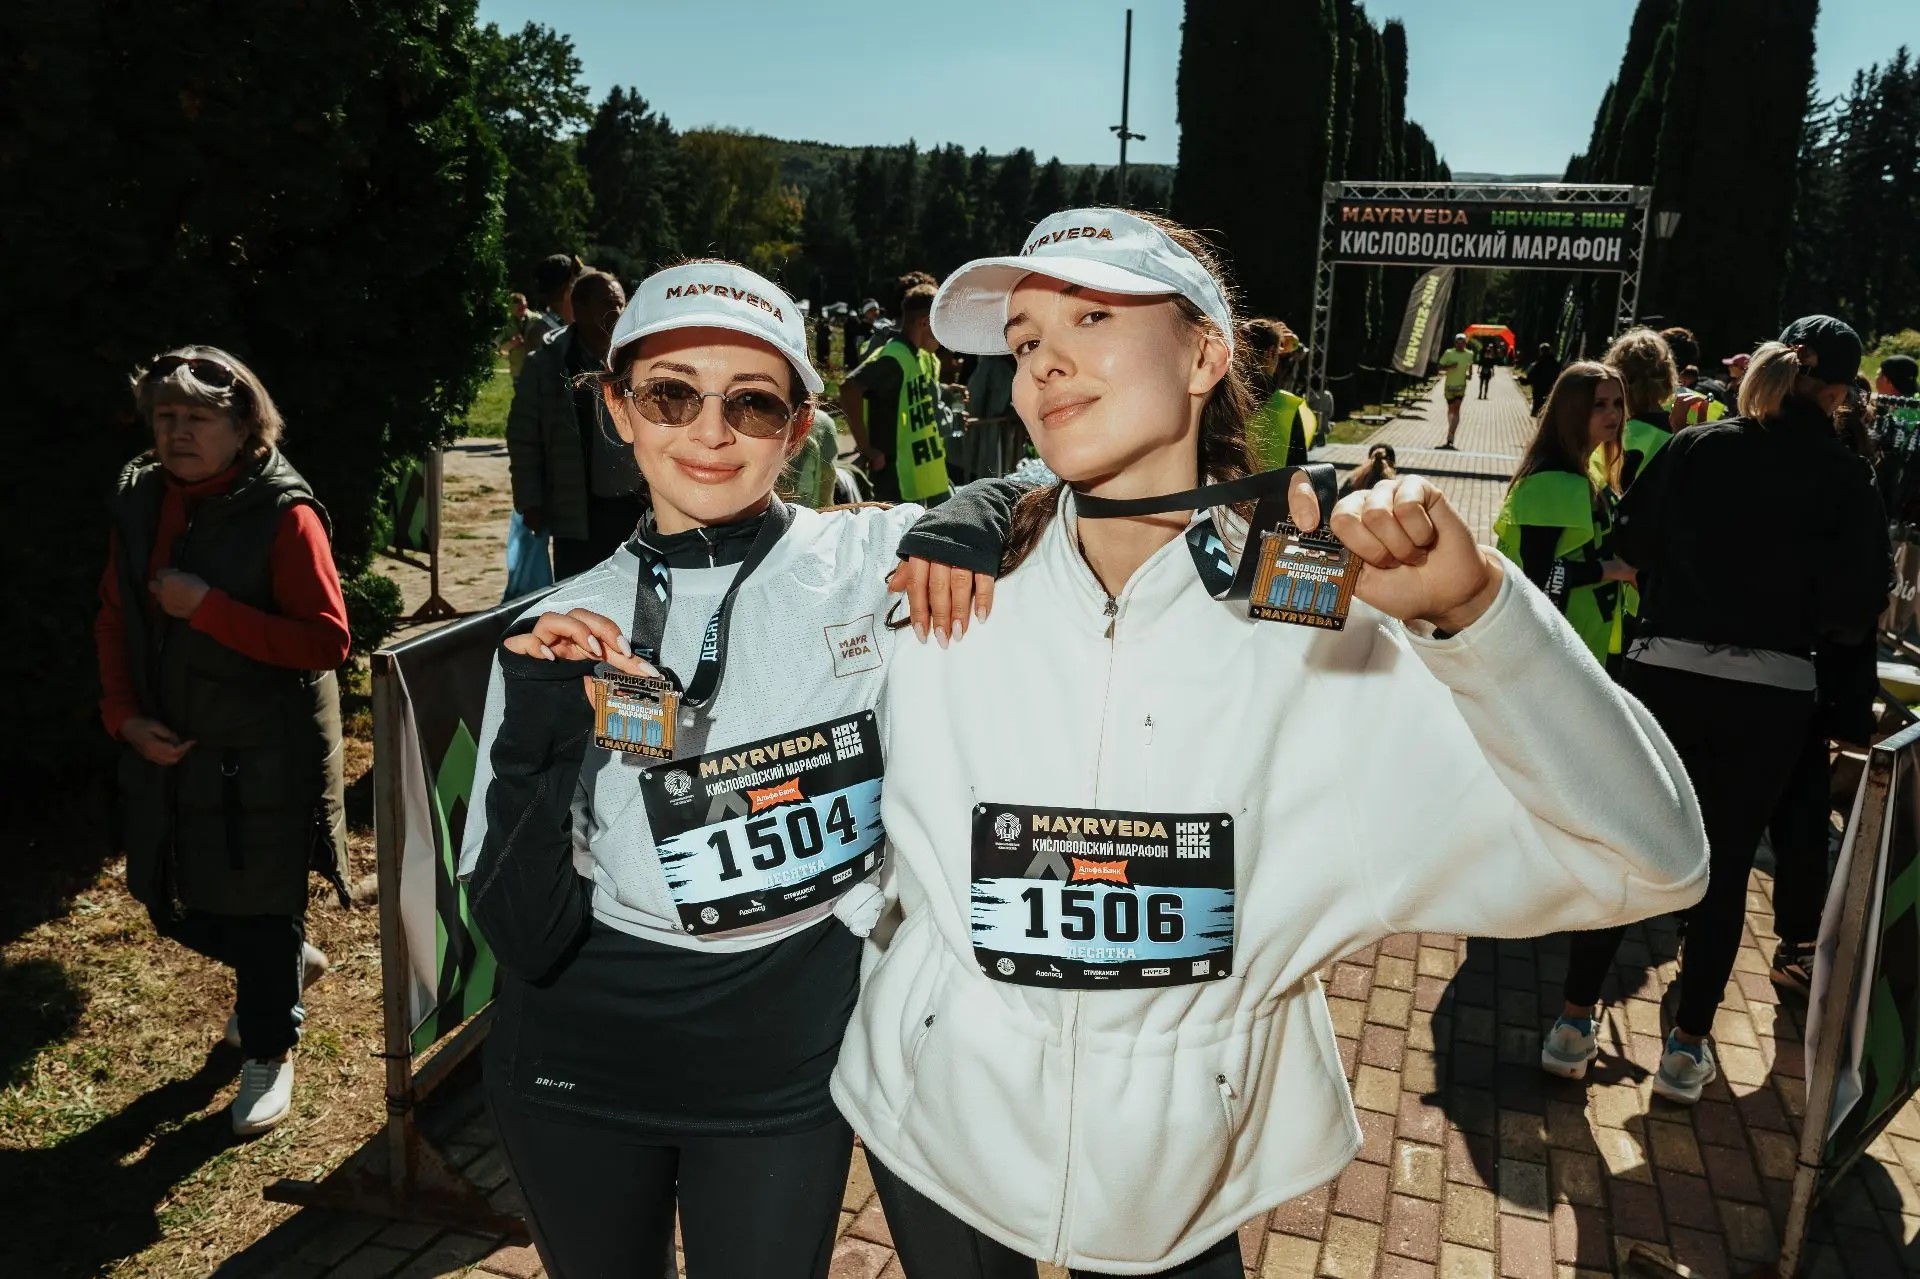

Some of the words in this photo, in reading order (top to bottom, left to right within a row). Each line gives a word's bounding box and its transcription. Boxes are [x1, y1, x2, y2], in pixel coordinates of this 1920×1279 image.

[1342, 206, 1469, 225] MAYRVEDA
[1340, 230, 1506, 259] КИСЛОВОДСКИЙ
[1511, 235, 1622, 263] МАРАФОН
[665, 283, 784, 323] MAYRVEDA
[1275, 560, 1345, 578] КИСЛОВОДСКИЙ
[1287, 570, 1329, 583] МАРАФОН
[1259, 608, 1333, 627] MAYRVEDA
[838, 634, 868, 649] MAYR
[841, 645, 871, 659] VEDA
[604, 740, 665, 758] MAYRVEDA
[699, 731, 828, 779] MAYRVEDA
[836, 744, 864, 761] RUN
[705, 764, 785, 797] КИСЛОВОДСКИЙ
[785, 752, 832, 777] МАРАФОН
[756, 792, 779, 805] Альфа
[778, 786, 797, 799] Банк
[1032, 814, 1169, 839] MAYRVEDA
[706, 793, 860, 882] 1504
[1032, 838, 1114, 856] КИСЛОВОДСКИЙ
[1116, 843, 1169, 859] МАРАФОН
[1176, 846, 1211, 859] RUN
[1078, 865, 1103, 875] Альфа
[1102, 866, 1122, 875] Банк
[1020, 887, 1186, 944] 1506
[1067, 946, 1137, 960] ДЕСЯТКА
[535, 1077, 576, 1090] DRI-FIT
